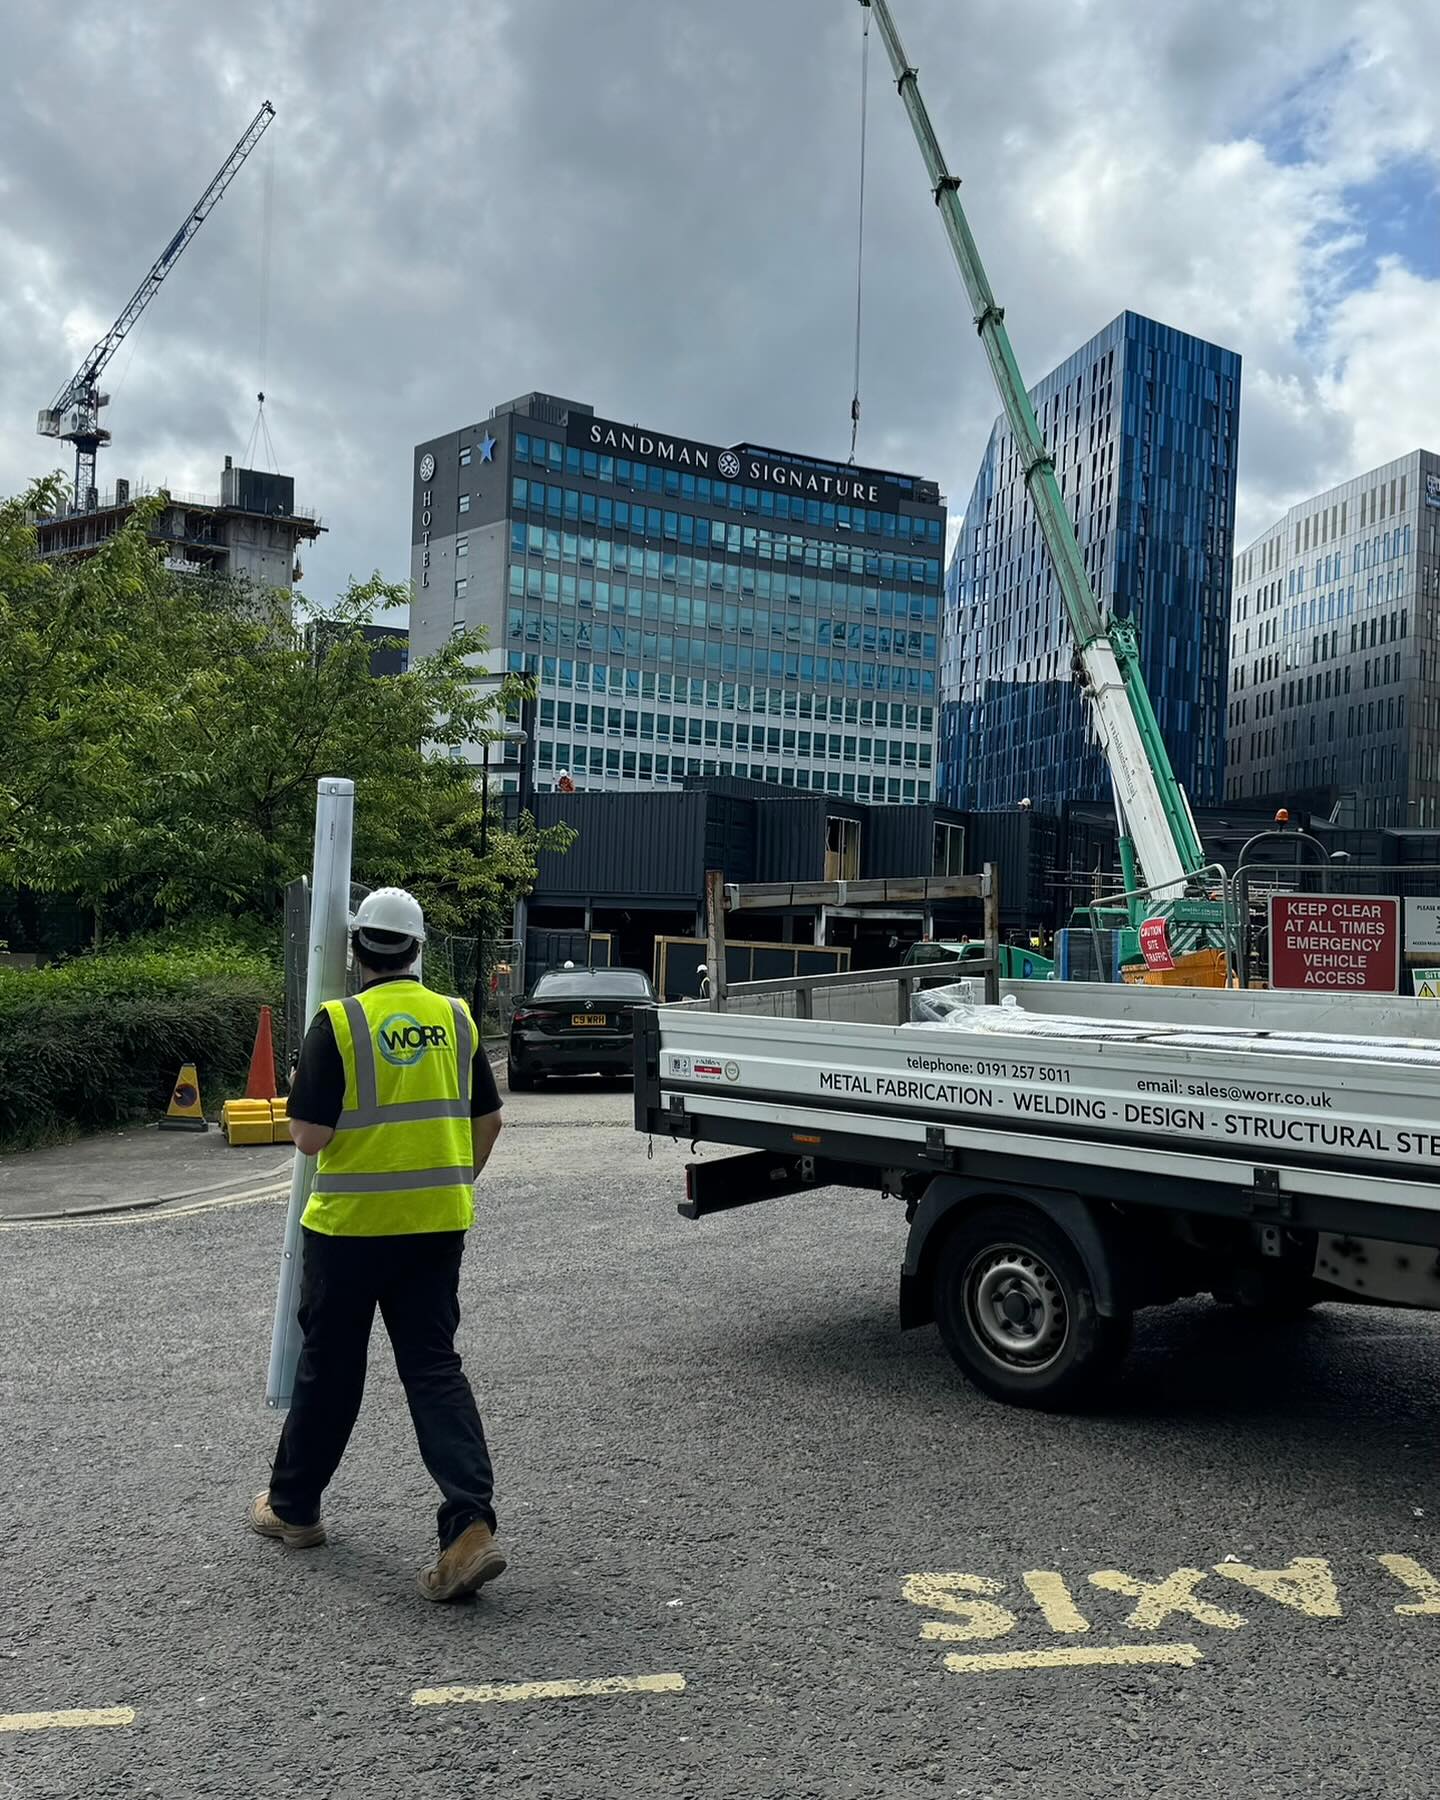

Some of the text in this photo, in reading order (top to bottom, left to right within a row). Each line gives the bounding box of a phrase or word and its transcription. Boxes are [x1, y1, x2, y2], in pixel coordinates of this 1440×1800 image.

[589, 425, 879, 502] SANDMAN SIGNATURE
[421, 490, 432, 588] HOTEL
[1287, 902, 1382, 918] KEEP CLEAR
[1140, 926, 1162, 937] CAUTION
[1284, 920, 1385, 936] AT ALL TIMES
[1147, 940, 1159, 950] SITE
[1287, 936, 1382, 951] EMERGENCY
[1146, 952, 1168, 962] TRAFFIC
[1303, 953, 1367, 968] VEHICLE
[1304, 971, 1366, 985] ACCESS
[573, 1015, 586, 1024] C9
[380, 1025, 448, 1050] WORR
[907, 1056, 1071, 1083] telephone: 0191 257 5011
[1137, 1079, 1332, 1108] email: sales@worr.co.uk
[819, 1072, 872, 1094] METAL
[876, 1078, 993, 1107] FABRICATION
[1013, 1092, 1106, 1120] WELDING
[1124, 1103, 1204, 1130] DESIGN
[1225, 1115, 1389, 1151] STRUCTURAL
[1397, 1132, 1440, 1156] STE
